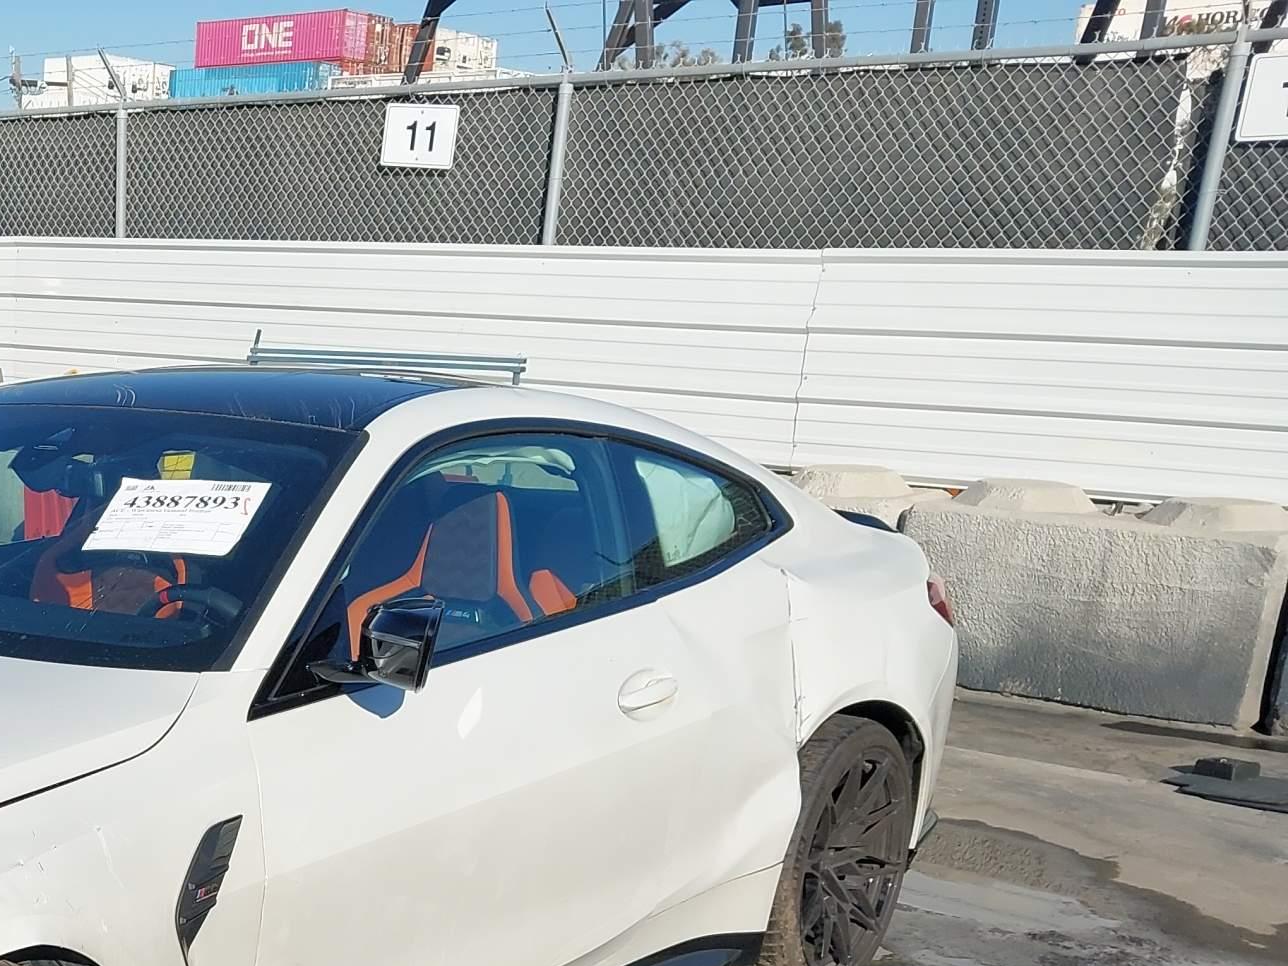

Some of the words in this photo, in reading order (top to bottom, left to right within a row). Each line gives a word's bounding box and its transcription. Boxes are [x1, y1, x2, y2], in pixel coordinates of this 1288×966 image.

[241, 20, 294, 51] ONE
[406, 120, 437, 153] 11
[124, 495, 241, 510] 43887893
